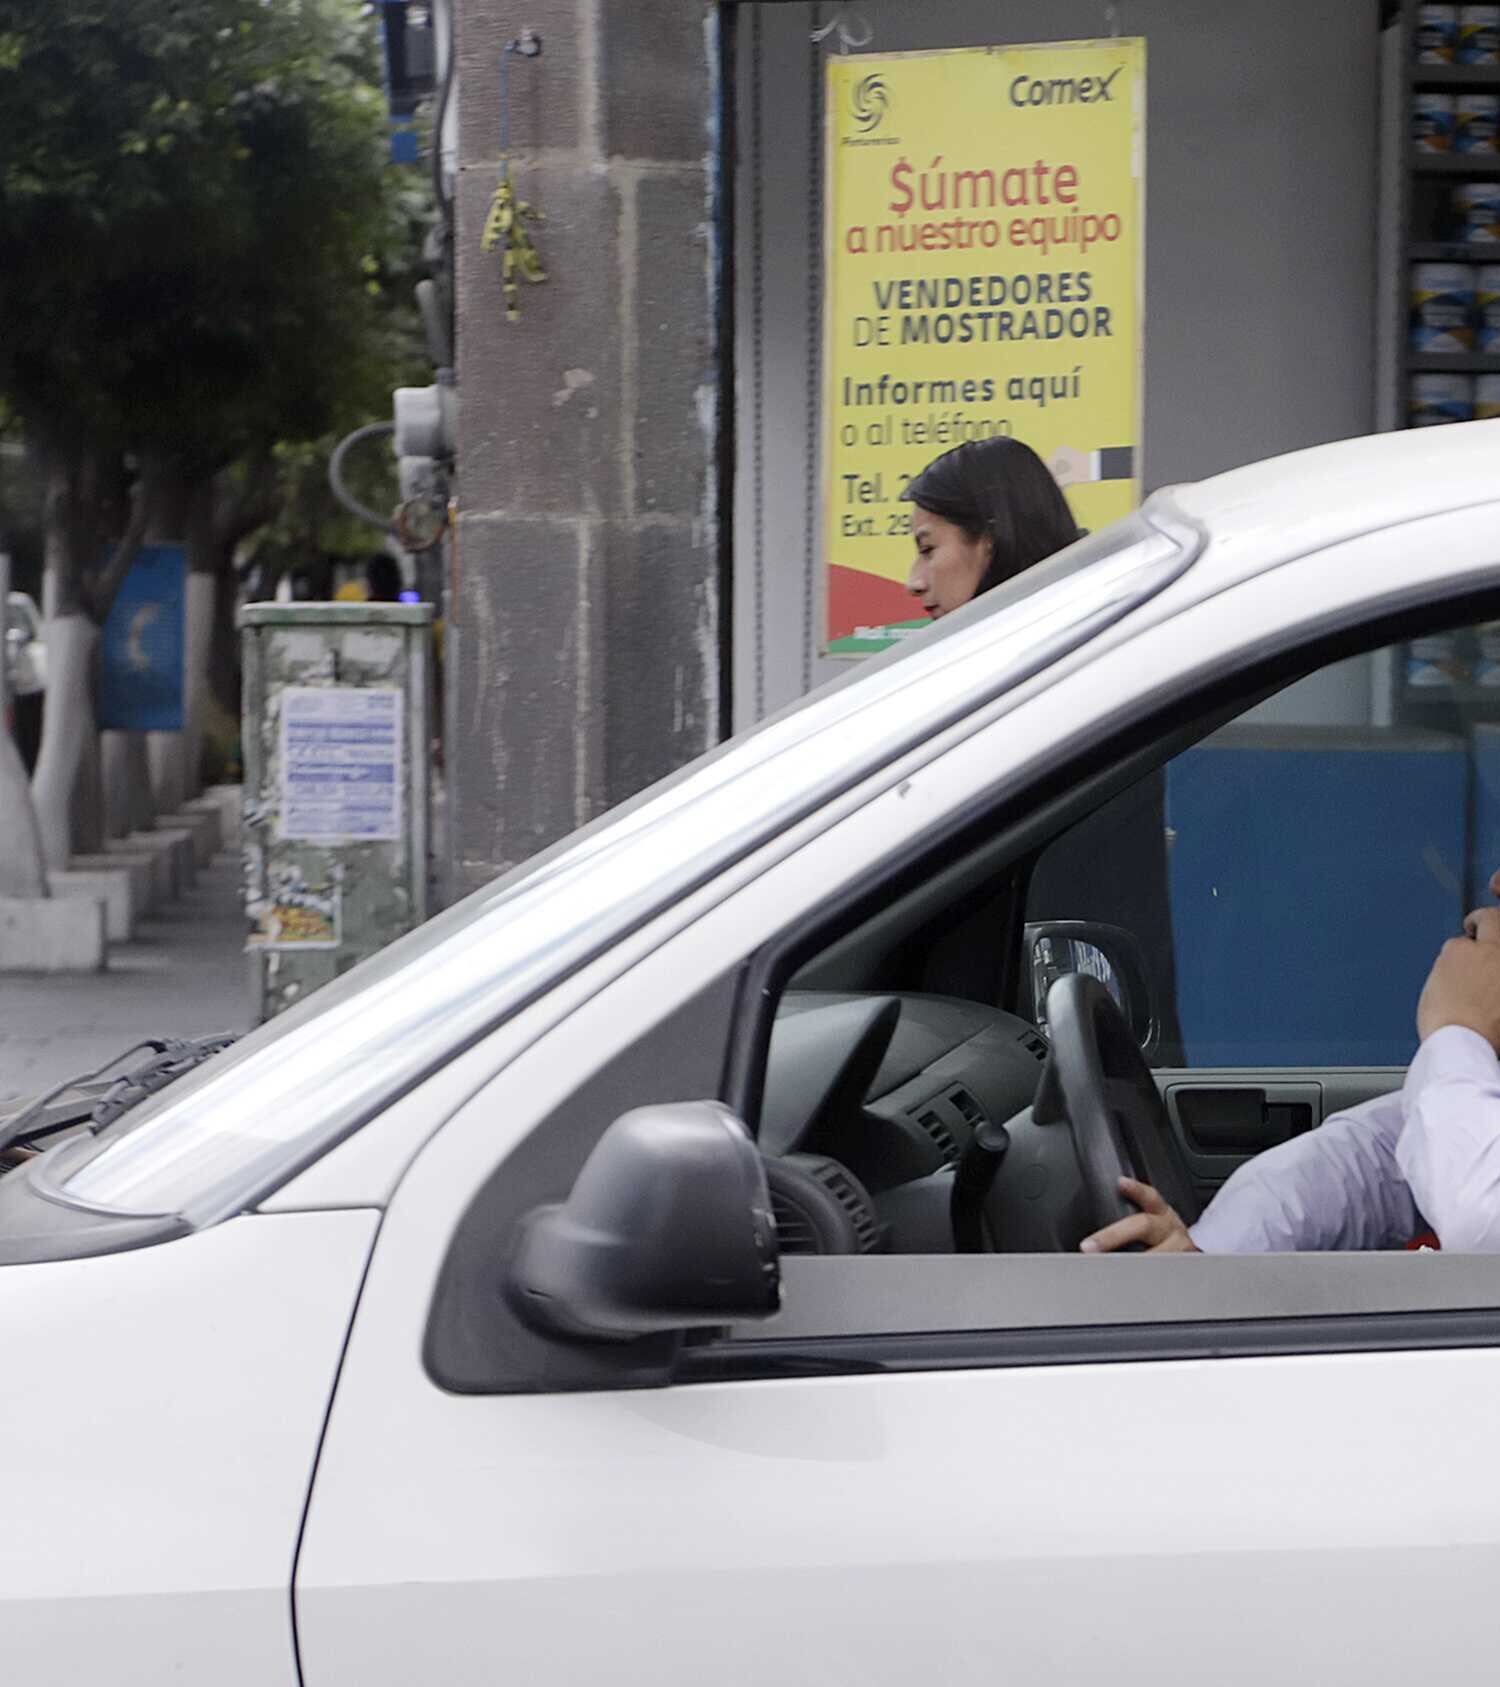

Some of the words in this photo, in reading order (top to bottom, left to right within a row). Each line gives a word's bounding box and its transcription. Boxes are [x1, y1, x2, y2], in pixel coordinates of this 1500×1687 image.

[1010, 65, 1125, 107] Comex
[846, 225, 868, 254] a
[876, 216, 1000, 252] nuestro
[1008, 207, 1121, 255] equipo
[873, 271, 1093, 311] VENDEDORES
[853, 316, 890, 347] DE
[901, 306, 1113, 345] MOSTRADOR
[841, 374, 995, 406] Informes
[1007, 366, 1083, 408] aquí
[839, 423, 859, 447] o
[865, 414, 893, 446] al
[903, 411, 1013, 445] teléfono
[842, 472, 889, 504] Tel.
[841, 513, 884, 537] Ext.
